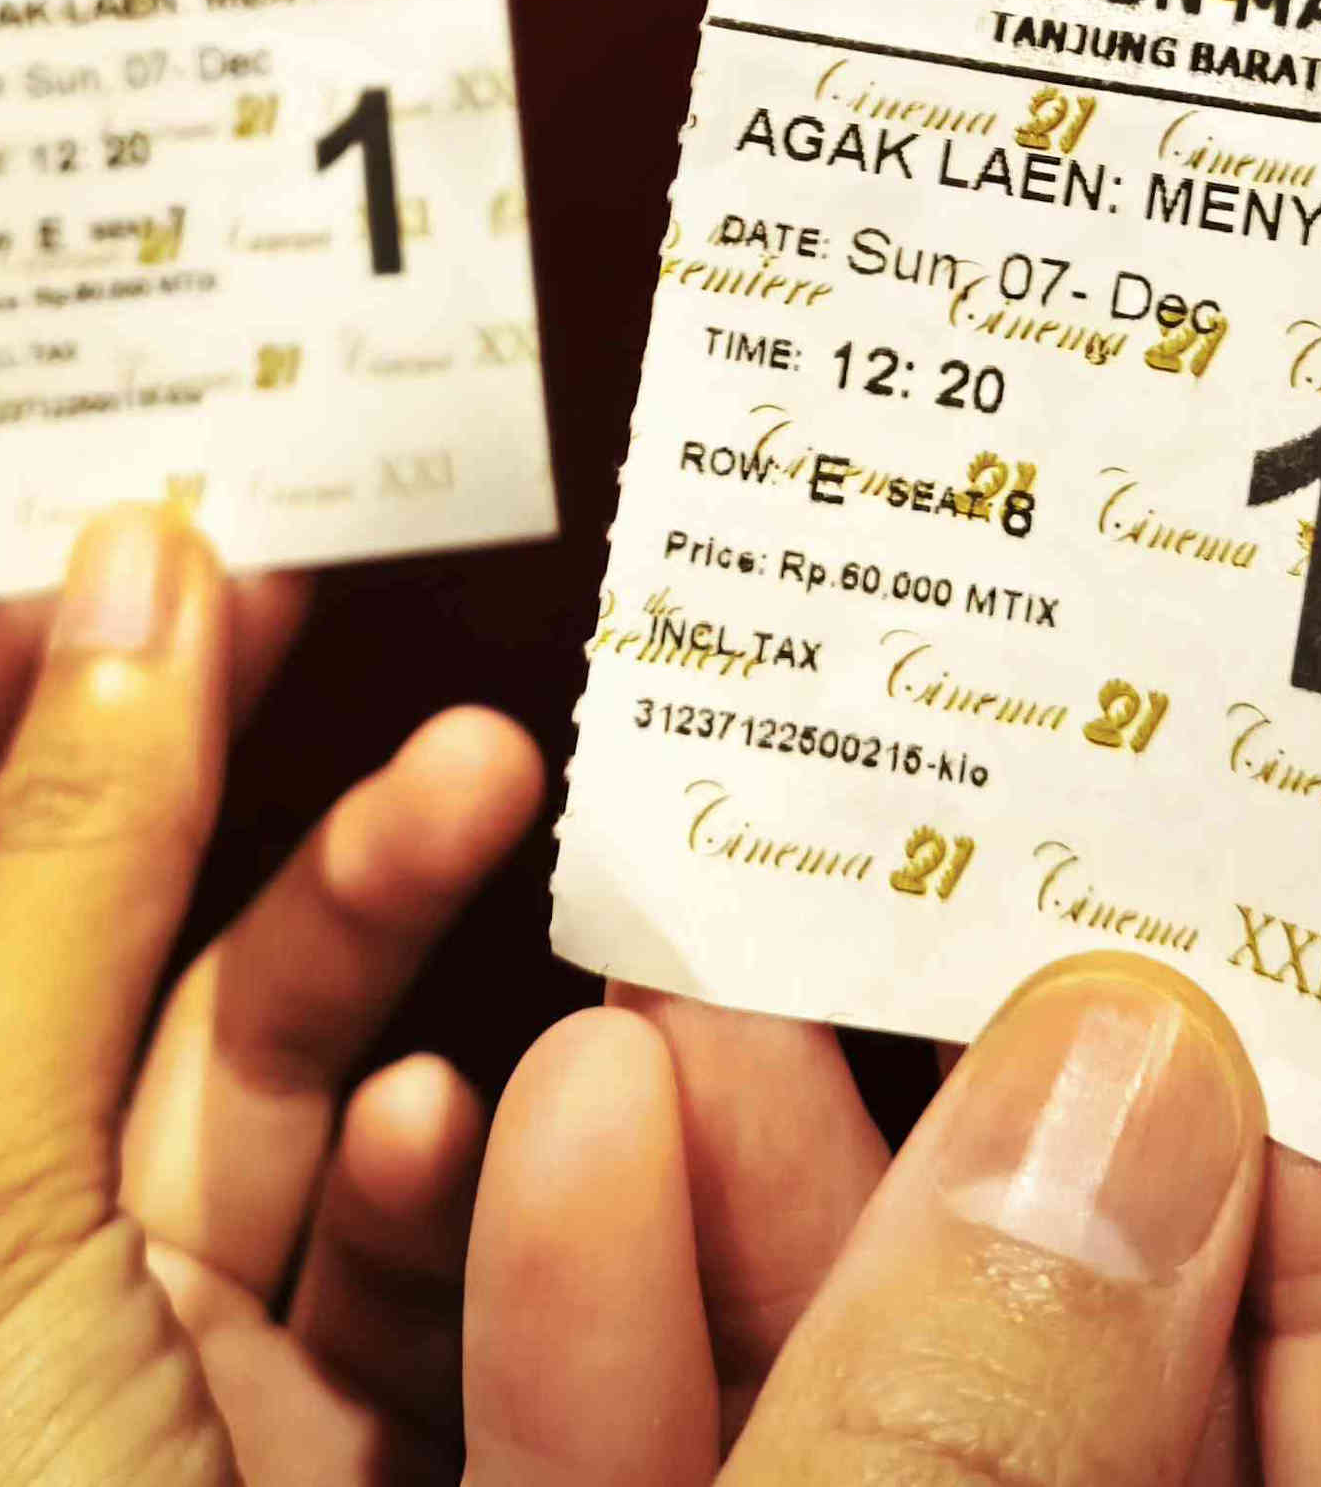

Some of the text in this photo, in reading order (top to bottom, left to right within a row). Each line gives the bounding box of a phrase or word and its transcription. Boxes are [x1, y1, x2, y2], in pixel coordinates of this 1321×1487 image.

[991, 10, 1178, 68] TANJUNG
[102, 130, 152, 169] 20
[316, 85, 406, 277] 1
[736, 107, 921, 180] AGAK
[938, 138, 1125, 214] LAEN:
[38, 215, 62, 254] E
[720, 214, 831, 260] DATE:
[1110, 270, 1223, 335] Dec
[705, 326, 803, 372] TIME:
[934, 358, 1006, 414] 20
[809, 452, 851, 505] E
[664, 529, 768, 576] Price:
[964, 582, 1061, 629] MTIX
[879, 628, 1069, 732] Cinema
[683, 778, 875, 881] Cinema
[1032, 840, 1200, 953] Cinema
